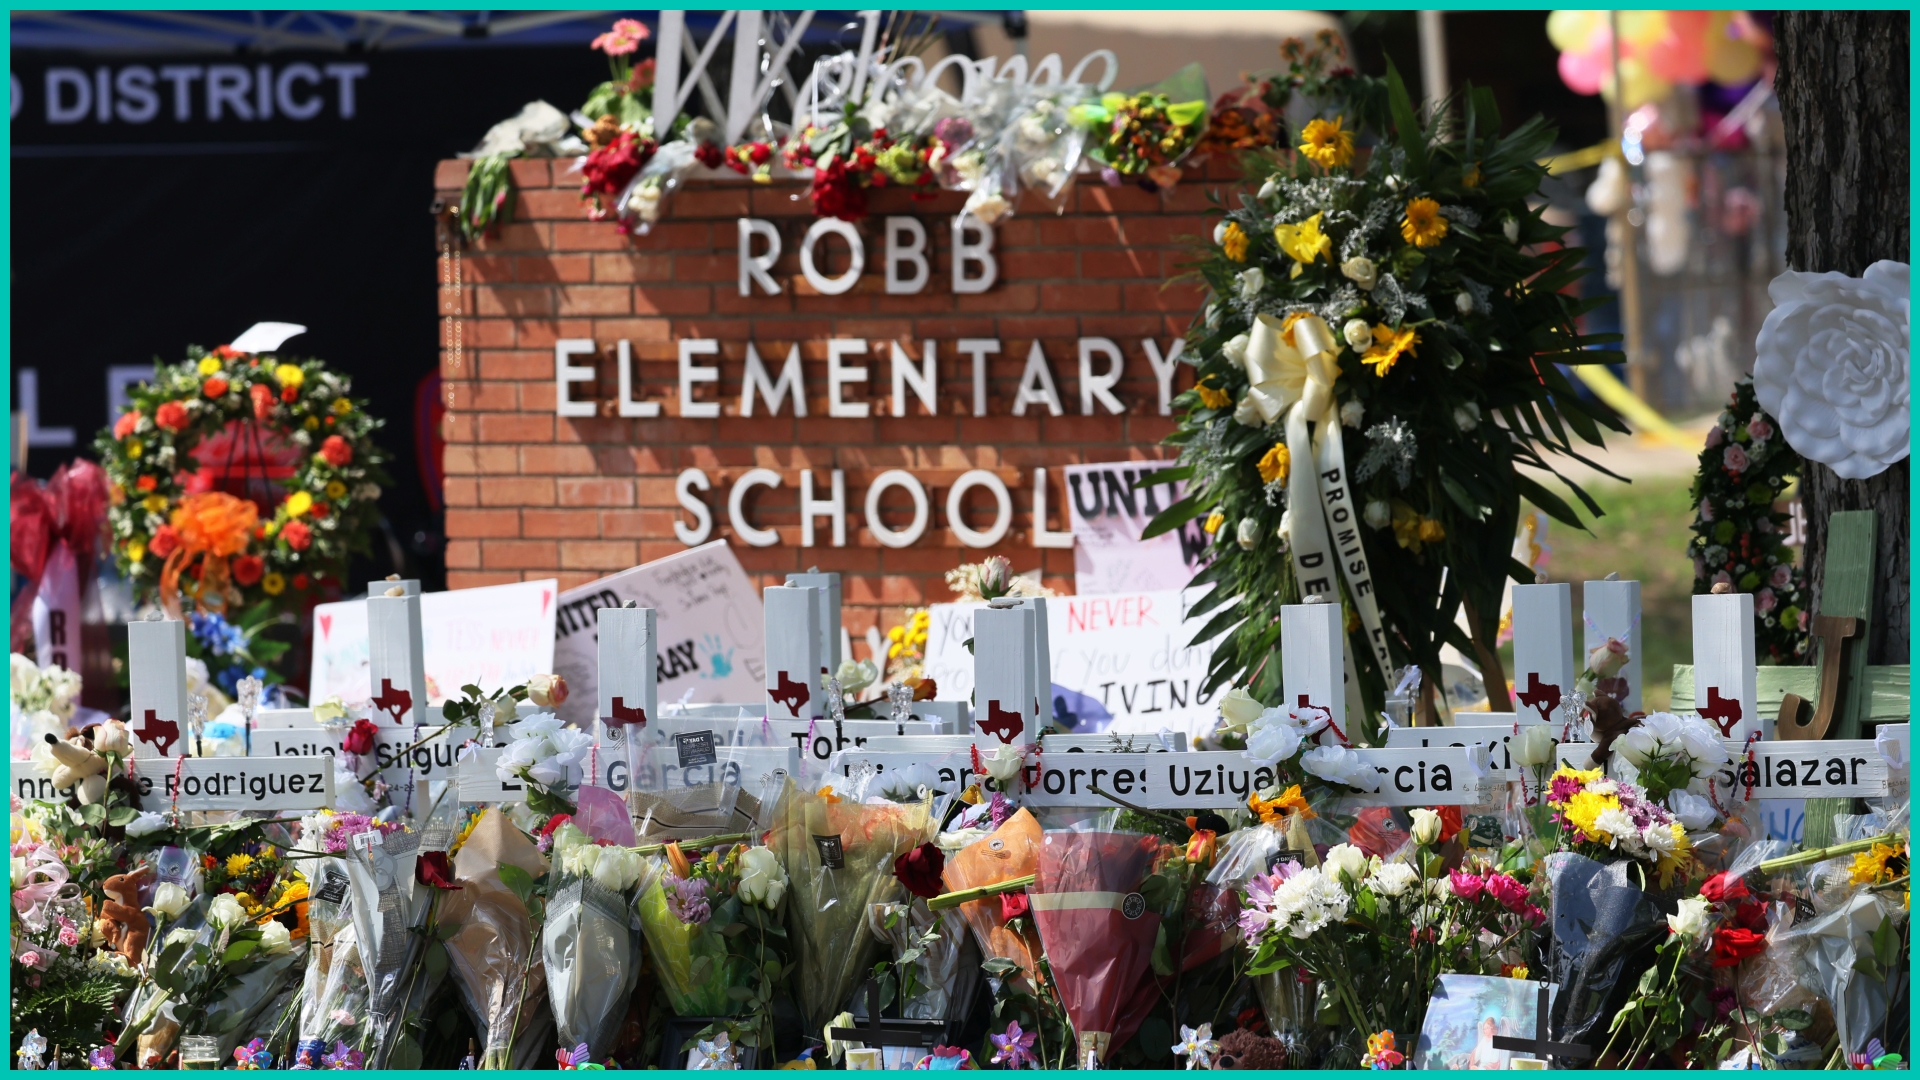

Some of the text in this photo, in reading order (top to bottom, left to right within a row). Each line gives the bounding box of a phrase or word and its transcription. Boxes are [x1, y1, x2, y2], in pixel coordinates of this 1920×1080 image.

[45, 64, 368, 123] DISTRICT
[737, 216, 998, 297] ROBB
[555, 337, 1185, 418] ELEMENTARY
[674, 467, 1075, 548] SCHOOL
[1321, 468, 1374, 598] PROMISE
[555, 588, 623, 641] NITED
[1068, 595, 1159, 633] NEVER
[657, 639, 700, 683] RAY
[1099, 675, 1213, 714] IVING
[165, 771, 324, 801] Rodriguez
[606, 760, 741, 792] Garcia
[1169, 764, 1276, 801] Uziya
[1723, 756, 1868, 788] Salazar
